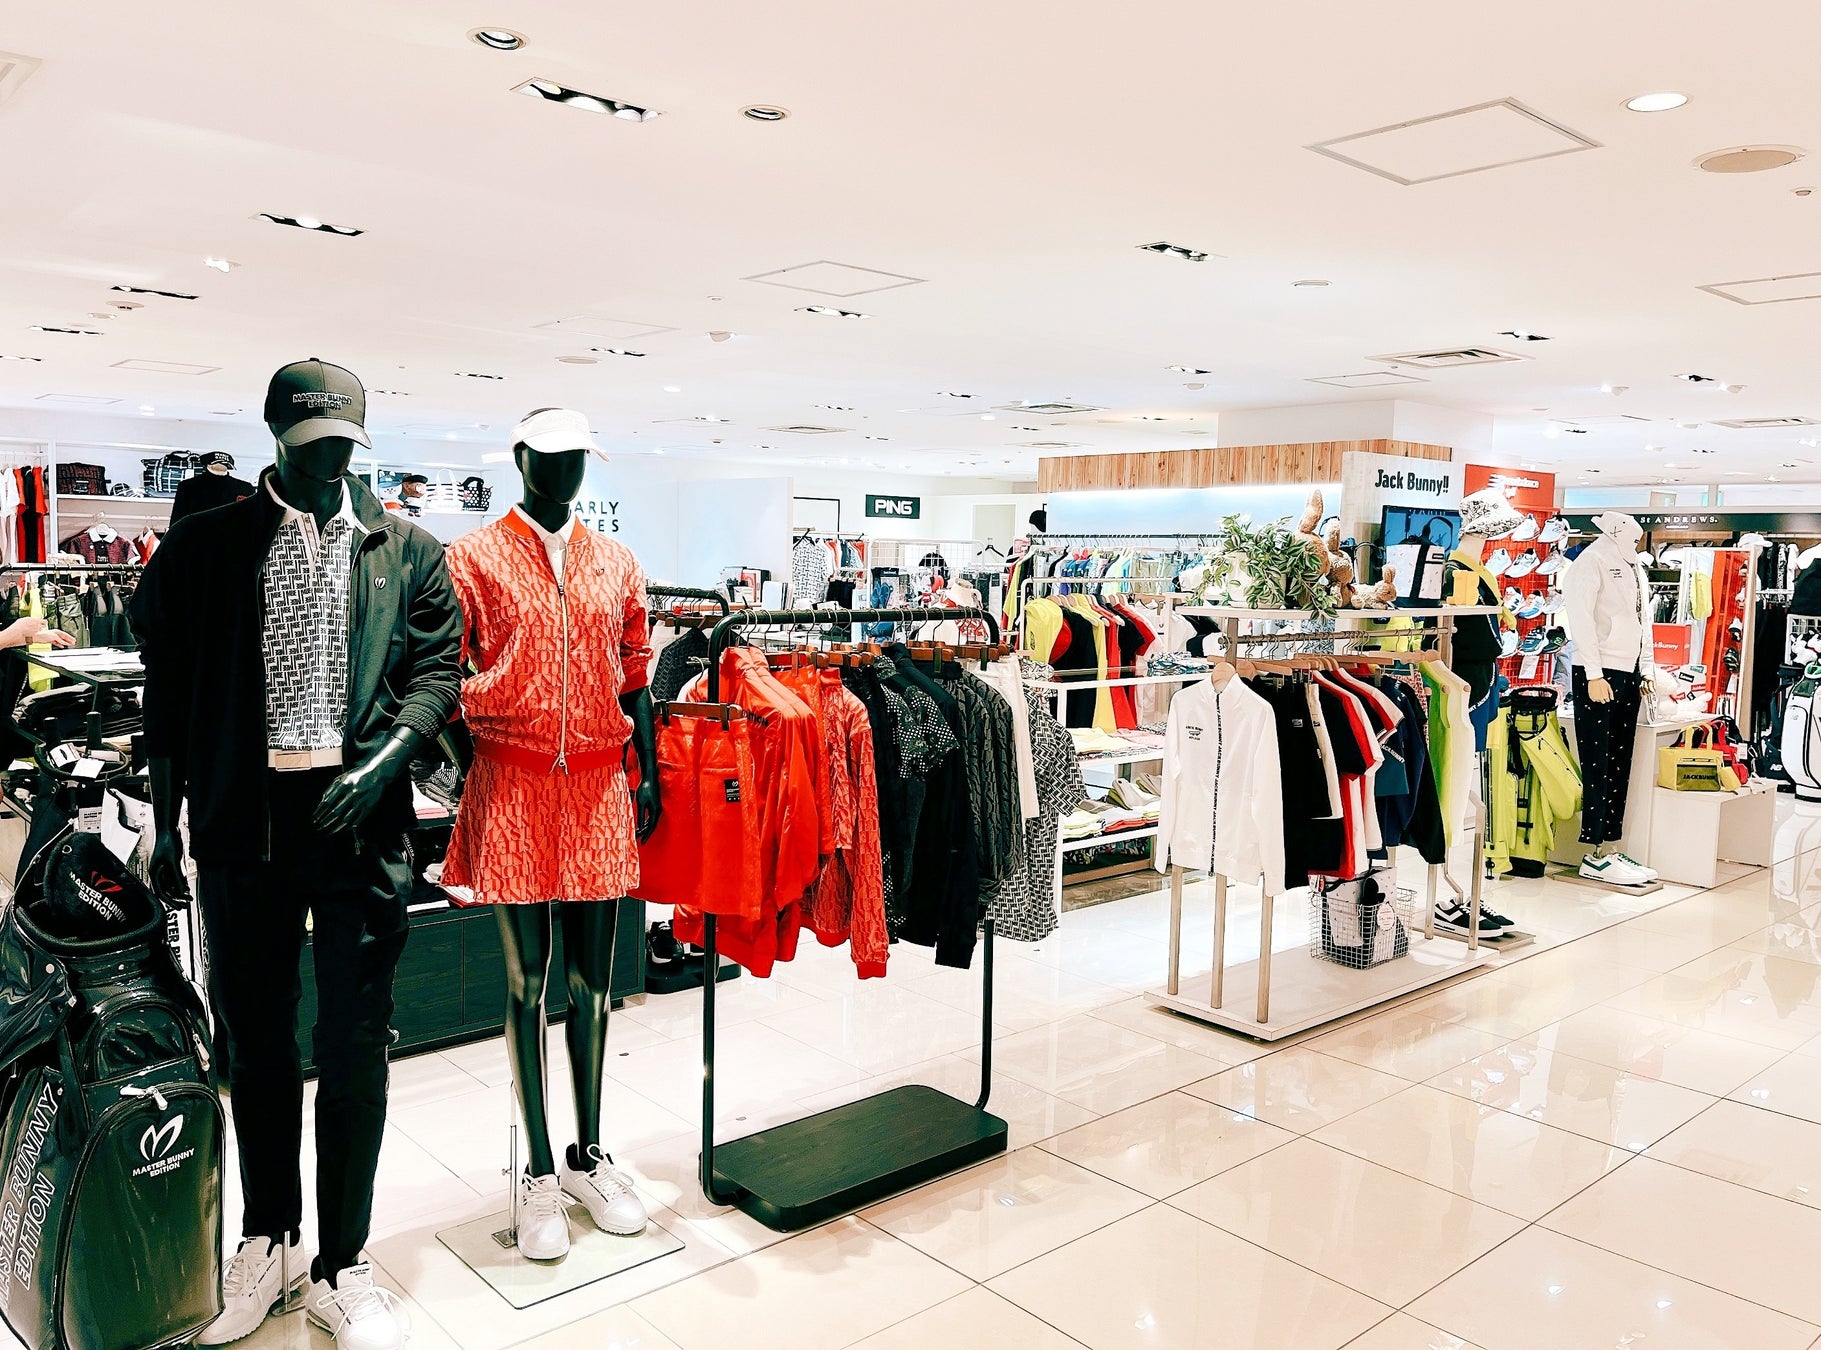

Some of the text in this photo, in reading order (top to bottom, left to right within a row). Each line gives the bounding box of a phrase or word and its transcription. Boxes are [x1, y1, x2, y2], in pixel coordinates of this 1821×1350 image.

[292, 392, 326, 403] MASTER
[1374, 469, 1449, 496] Jack Bunny!!
[574, 501, 619, 515] ARLY
[875, 499, 913, 515] PING
[582, 518, 619, 532] TES
[69, 871, 126, 922] MASTER BUNNY
[78, 889, 112, 921] EDITION
[167, 913, 180, 943] STER
[10, 1082, 58, 1207] BUNNY
[132, 1148, 195, 1177] MASTER BUNNY
[149, 1161, 181, 1177] EDITION
[14, 1171, 56, 1291] EDITION
